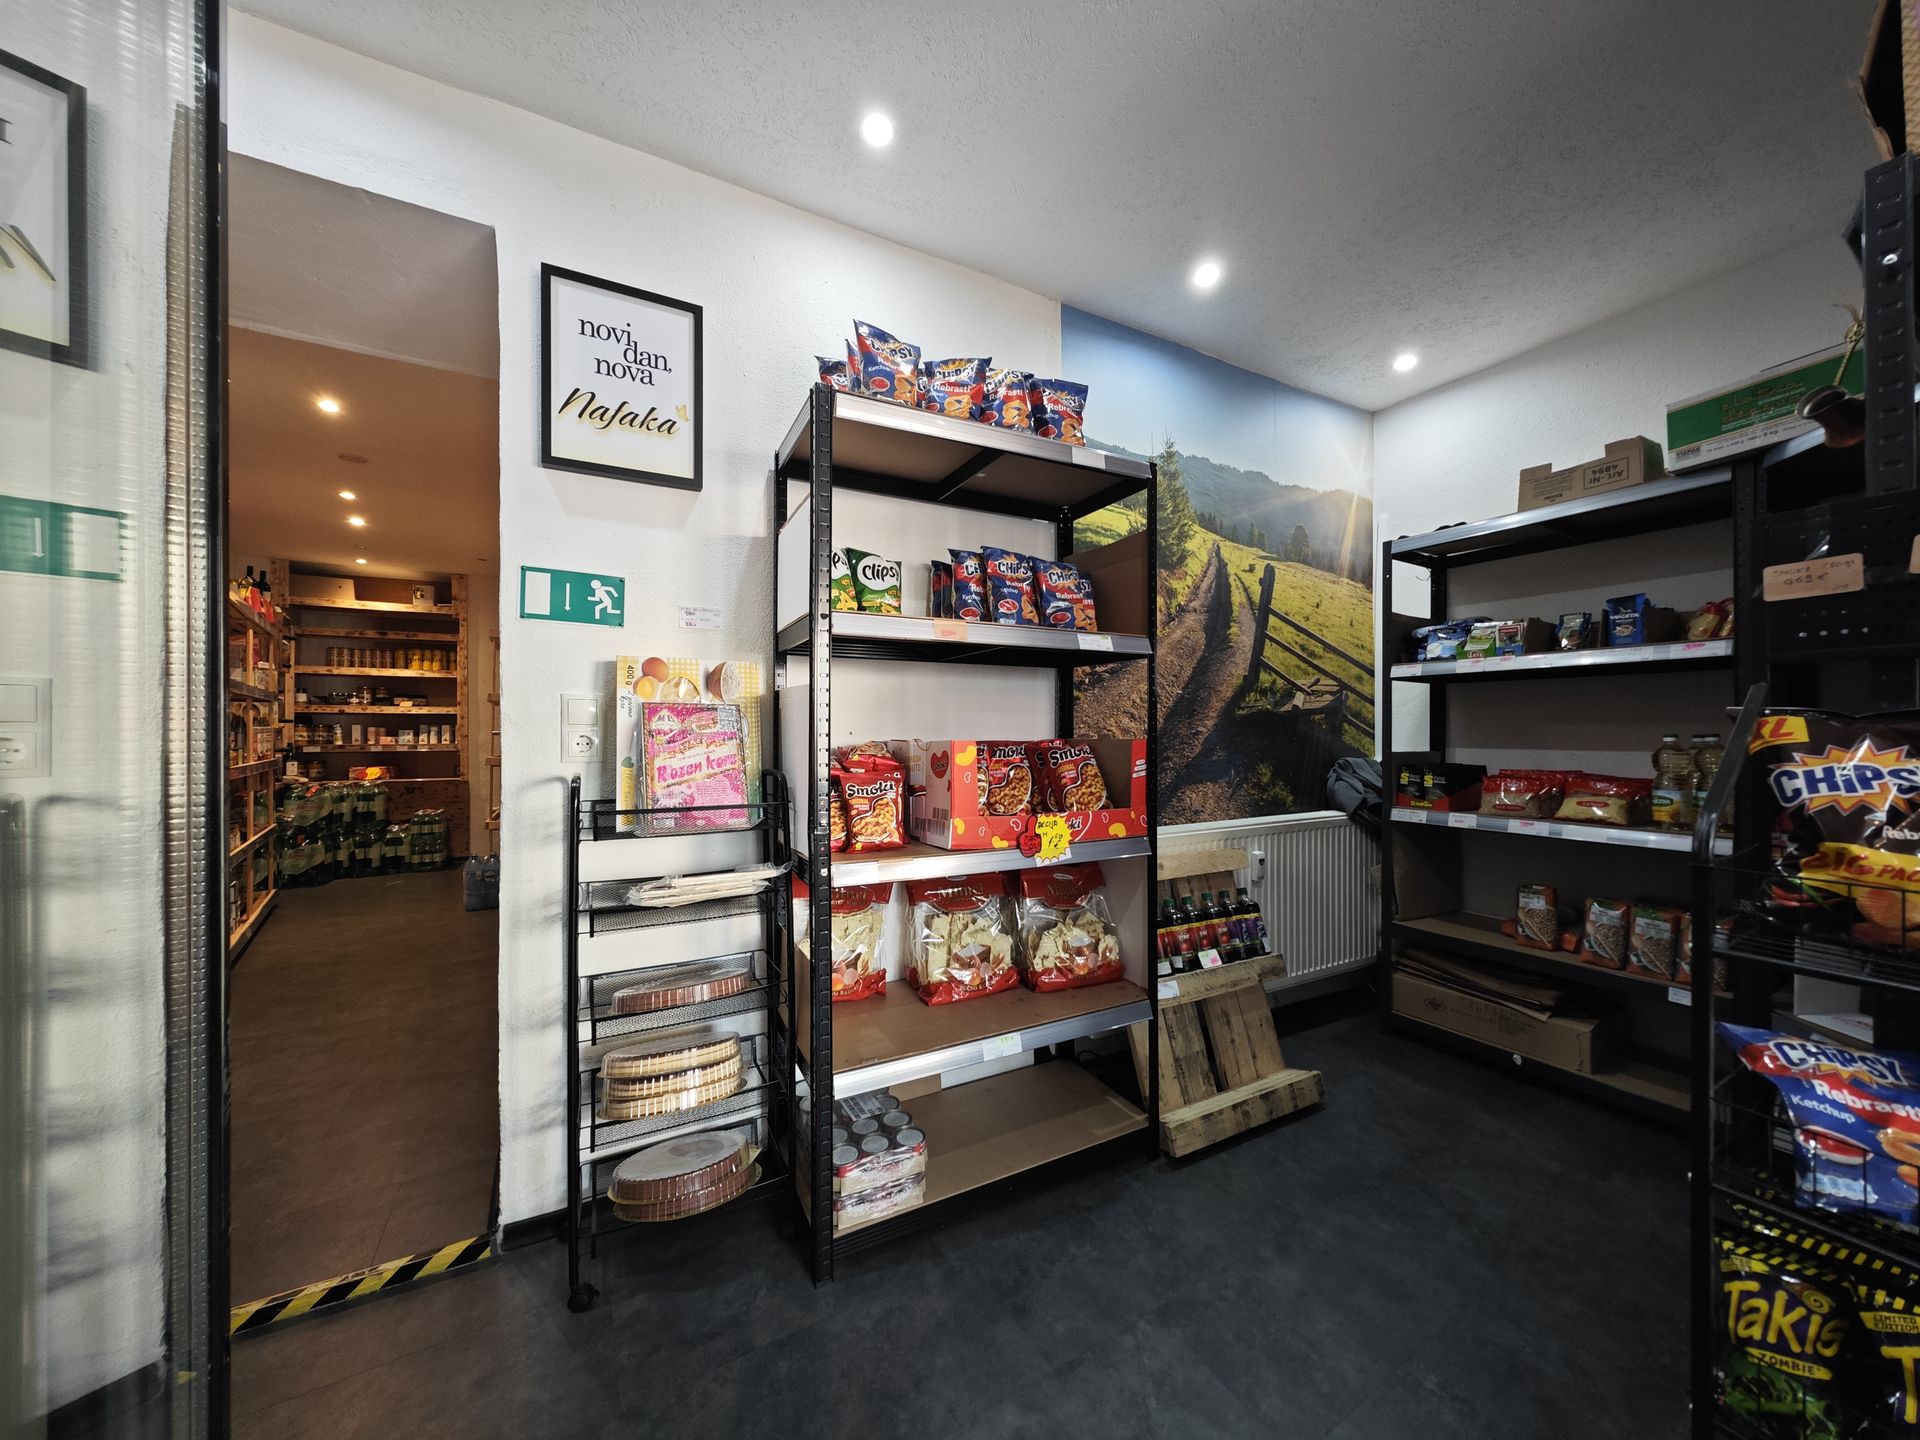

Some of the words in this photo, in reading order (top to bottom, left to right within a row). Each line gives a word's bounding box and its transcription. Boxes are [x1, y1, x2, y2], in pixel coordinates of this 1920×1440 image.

[577, 318, 633, 347] novi
[593, 357, 655, 386] nova
[623, 341, 672, 374] dan,
[557, 387, 681, 435] Nafaka
[626, 664, 635, 680] 400
[846, 780, 896, 798] Smoki
[1800, 851, 1874, 876] BIG
[1877, 864, 1920, 882] PAC
[1790, 1094, 1857, 1124] Ketchup
[1723, 1280, 1850, 1357] Takis
[1874, 1314, 1917, 1325] LIMITED
[1760, 1353, 1815, 1375] ZOMBIE
